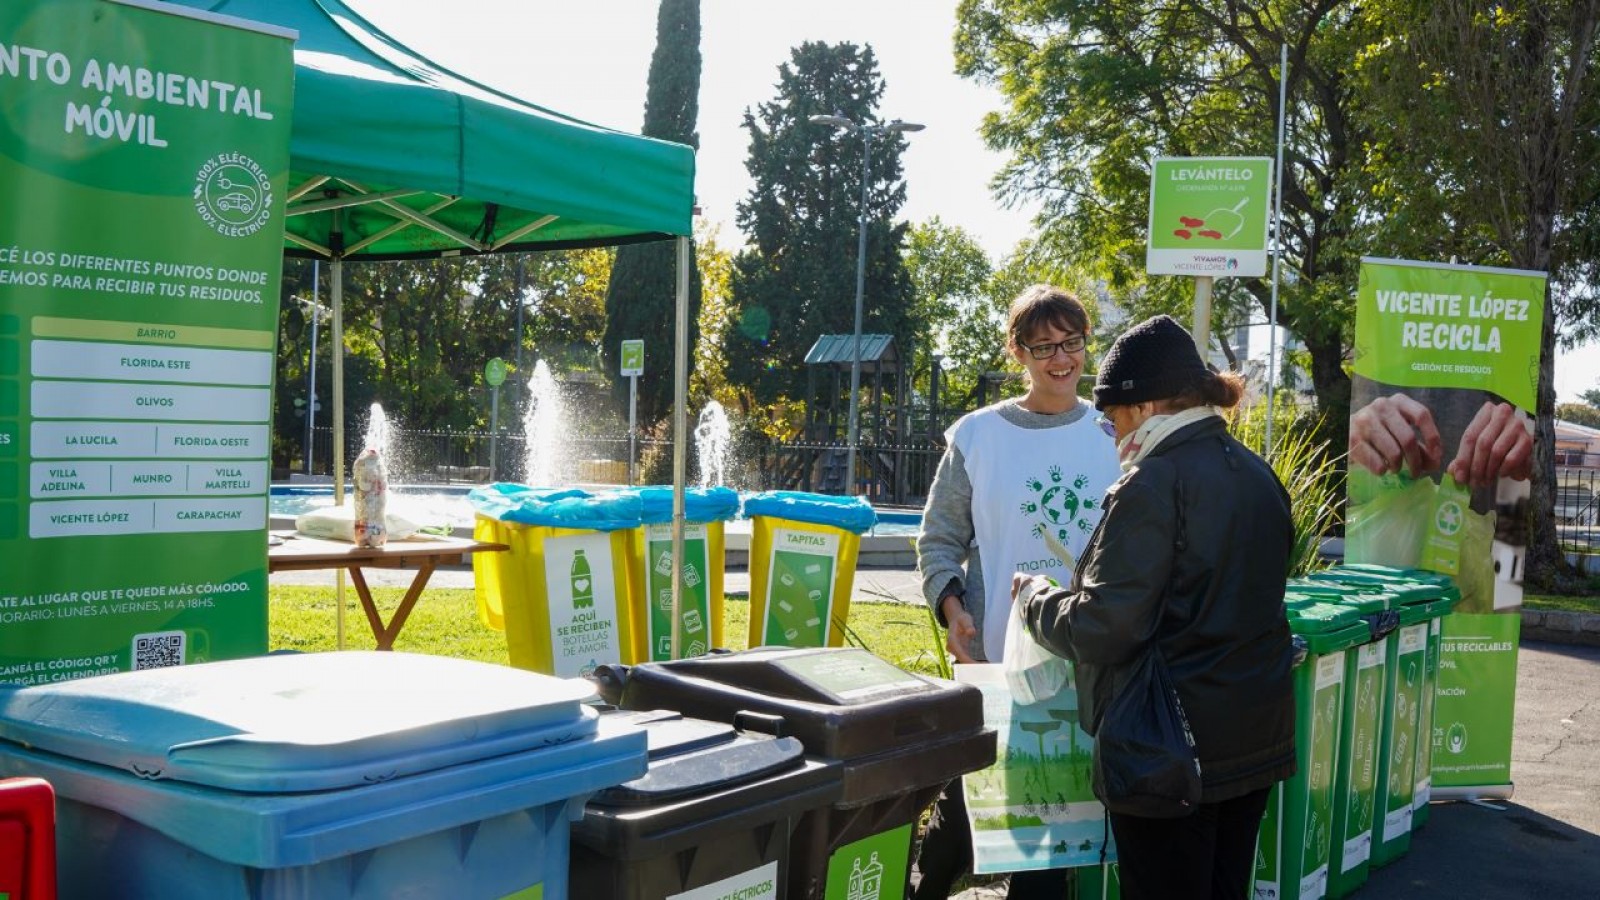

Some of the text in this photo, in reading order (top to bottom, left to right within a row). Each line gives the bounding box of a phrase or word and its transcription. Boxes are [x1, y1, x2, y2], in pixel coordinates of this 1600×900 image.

[82, 58, 273, 120] AMBIENTAL
[65, 95, 168, 147] MÓVIL
[196, 151, 271, 191] 100% ELÉCTRICO
[1171, 167, 1253, 181] LEVÁNTELO
[195, 201, 270, 237] 100% ELÉCTRICO
[24, 250, 55, 266] LOS
[60, 253, 150, 275] DIFERENTES
[154, 262, 214, 280] PUNTOS
[217, 268, 268, 285] DONDE
[52, 273, 92, 290] PARA
[95, 277, 156, 295] RECIBIR
[159, 283, 186, 297] TUS
[189, 285, 264, 304] RESIDUOS.
[1375, 290, 1530, 321] VICENTE LÓPEZ
[137, 328, 176, 340] BARRIO
[1402, 321, 1502, 353] RECICLA
[120, 357, 191, 370] FLORIDA ESTE
[1411, 361, 1492, 375] GESTIÓN DE RESIDUOS
[136, 396, 174, 407] OLIVOS
[65, 435, 118, 446] LA LUCILA
[174, 436, 249, 447] FLORIDA OESTE
[50, 469, 77, 479] VILLA
[133, 474, 172, 484] MUNRO
[215, 468, 242, 478] VILLA
[40, 481, 86, 492] ADELINA
[205, 480, 250, 490] MARTELLI
[50, 511, 129, 524] VICENTE LÓPEZ
[176, 510, 242, 521] CARAPACHAY
[787, 533, 826, 546] TAPITAS
[1016, 557, 1063, 571] manos
[21, 594, 36, 607] AL
[39, 592, 79, 605] LUGAR
[81, 590, 108, 604] QUE
[110, 589, 123, 600] TE
[126, 586, 166, 600] QUEDE
[168, 582, 193, 596] MÁS
[195, 582, 250, 595] CÓMODO.
[58, 606, 97, 618] LUNES
[99, 605, 109, 615] A
[110, 600, 161, 613] VIERNES,
[164, 599, 175, 609] 14
[176, 599, 186, 609] A
[187, 597, 216, 609] 18HS.
[572, 610, 596, 623] AQUÍ
[557, 619, 611, 636] SE RECIBEN
[563, 631, 608, 646] BOTELLAS
[563, 647, 576, 657] DE
[1456, 641, 1513, 652] RECICLABLES
[34, 662, 46, 672] EL
[48, 658, 92, 671] CÓDIGO
[94, 656, 110, 667] QR
[110, 654, 118, 664] Y
[38, 673, 50, 684] EL
